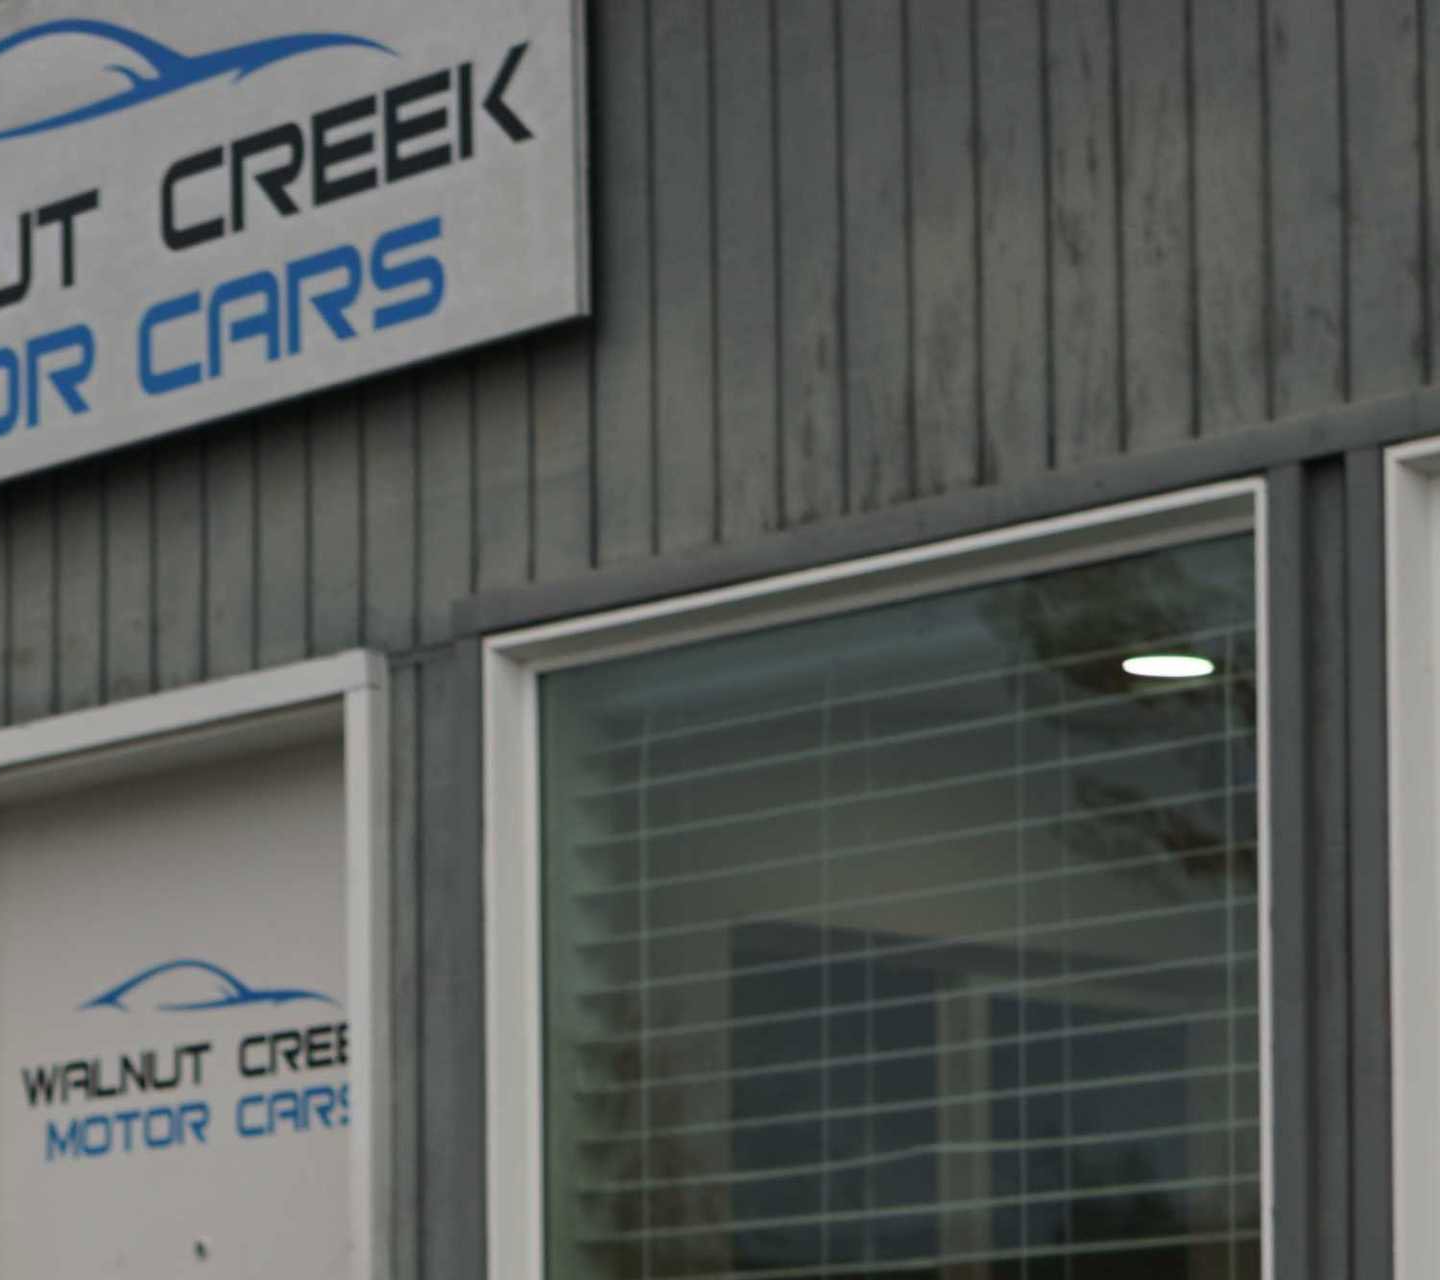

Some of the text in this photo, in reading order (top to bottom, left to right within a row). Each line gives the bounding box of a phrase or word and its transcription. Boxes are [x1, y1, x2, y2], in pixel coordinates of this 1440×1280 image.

[160, 41, 533, 251] CREEK
[138, 215, 445, 396] CARS
[22, 1042, 212, 1108] WALNUT
[46, 1098, 210, 1161] MOTOR
